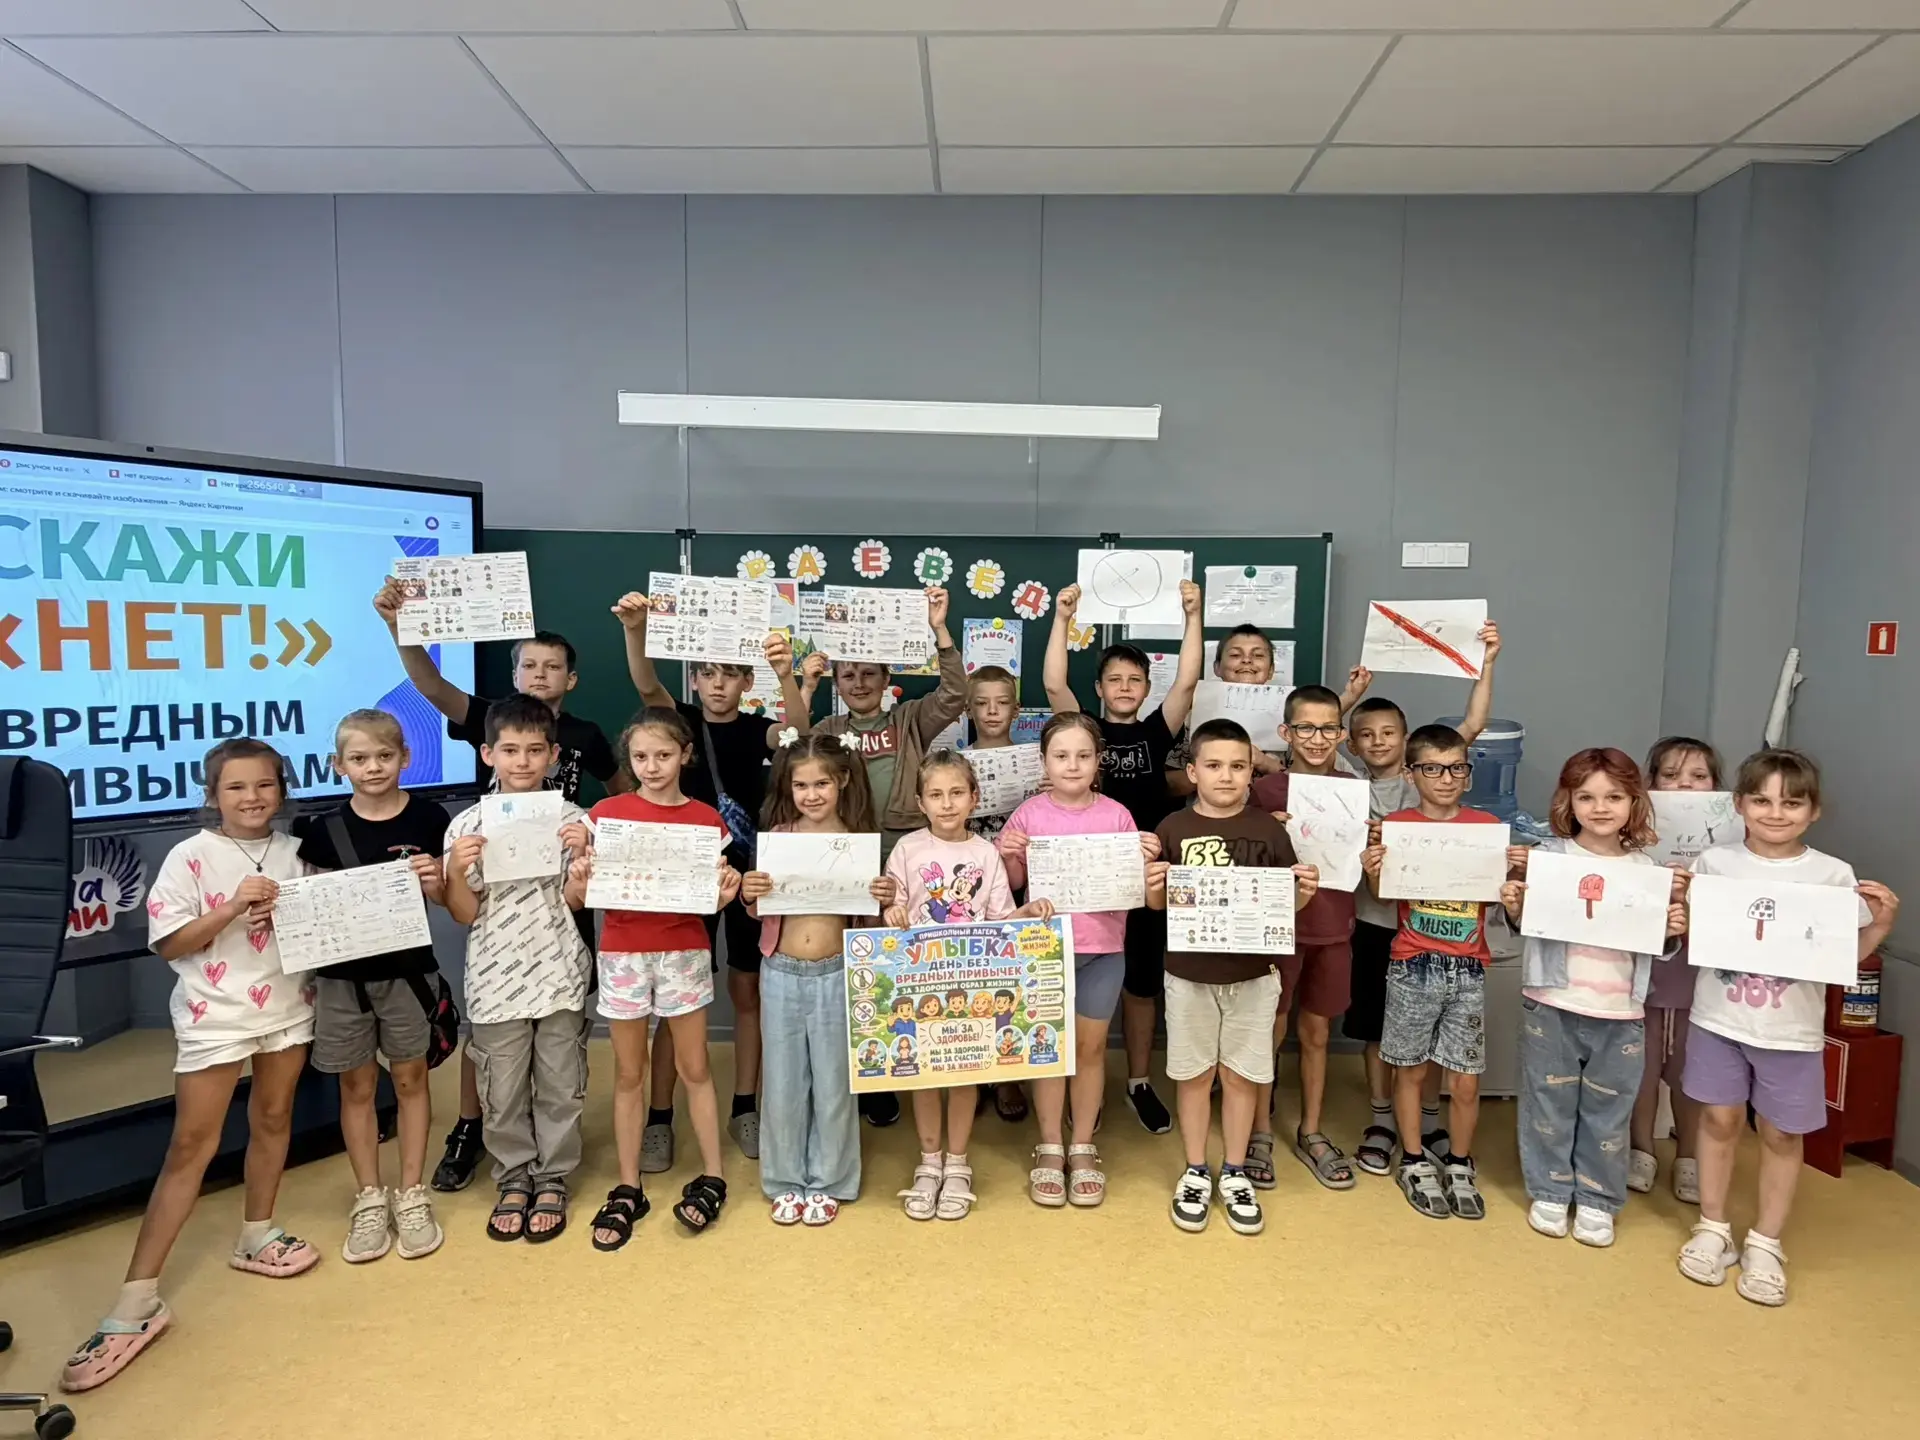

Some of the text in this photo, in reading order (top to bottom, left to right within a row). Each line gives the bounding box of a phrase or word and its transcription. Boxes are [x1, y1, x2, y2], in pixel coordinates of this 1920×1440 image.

[246, 479, 284, 492] 256540
[10, 487, 53, 496] смотрите
[62, 490, 112, 501] скачивайте
[113, 494, 169, 505] изображения
[179, 499, 206, 509] Яндекс
[207, 502, 244, 512] Картинки
[0, 514, 306, 589] СКАЖИ
[970, 631, 1015, 644] ГРАМОТА
[0, 700, 306, 753] ВРЕДНЫМ
[972, 927, 998, 936] ЛАГЕРЬ
[1417, 916, 1464, 938] MUSIC
[904, 938, 1017, 965] УЛЫБКА
[929, 957, 990, 972] ДЕНЬ БЕЗ
[896, 966, 1022, 984] ВРЕДНЫХ ПРИВЫЧЕК
[901, 979, 1016, 995] ЗА ЗДОРОВЫЙ ОБРАЗ ЖИЗНИ!
[1726, 975, 1789, 1009] JOY
[941, 1023, 974, 1035] МЫ ЗА
[937, 1032, 980, 1045] ЗДОРОВЬЕ!
[930, 1044, 990, 1056] МЫ ЗА ЗДОРОВЬЕ!
[930, 1052, 984, 1064] МЫ ЗА СЧАСТЬЕ!
[932, 1061, 983, 1072] МЫ ЗА ЖИЗНЬ!
